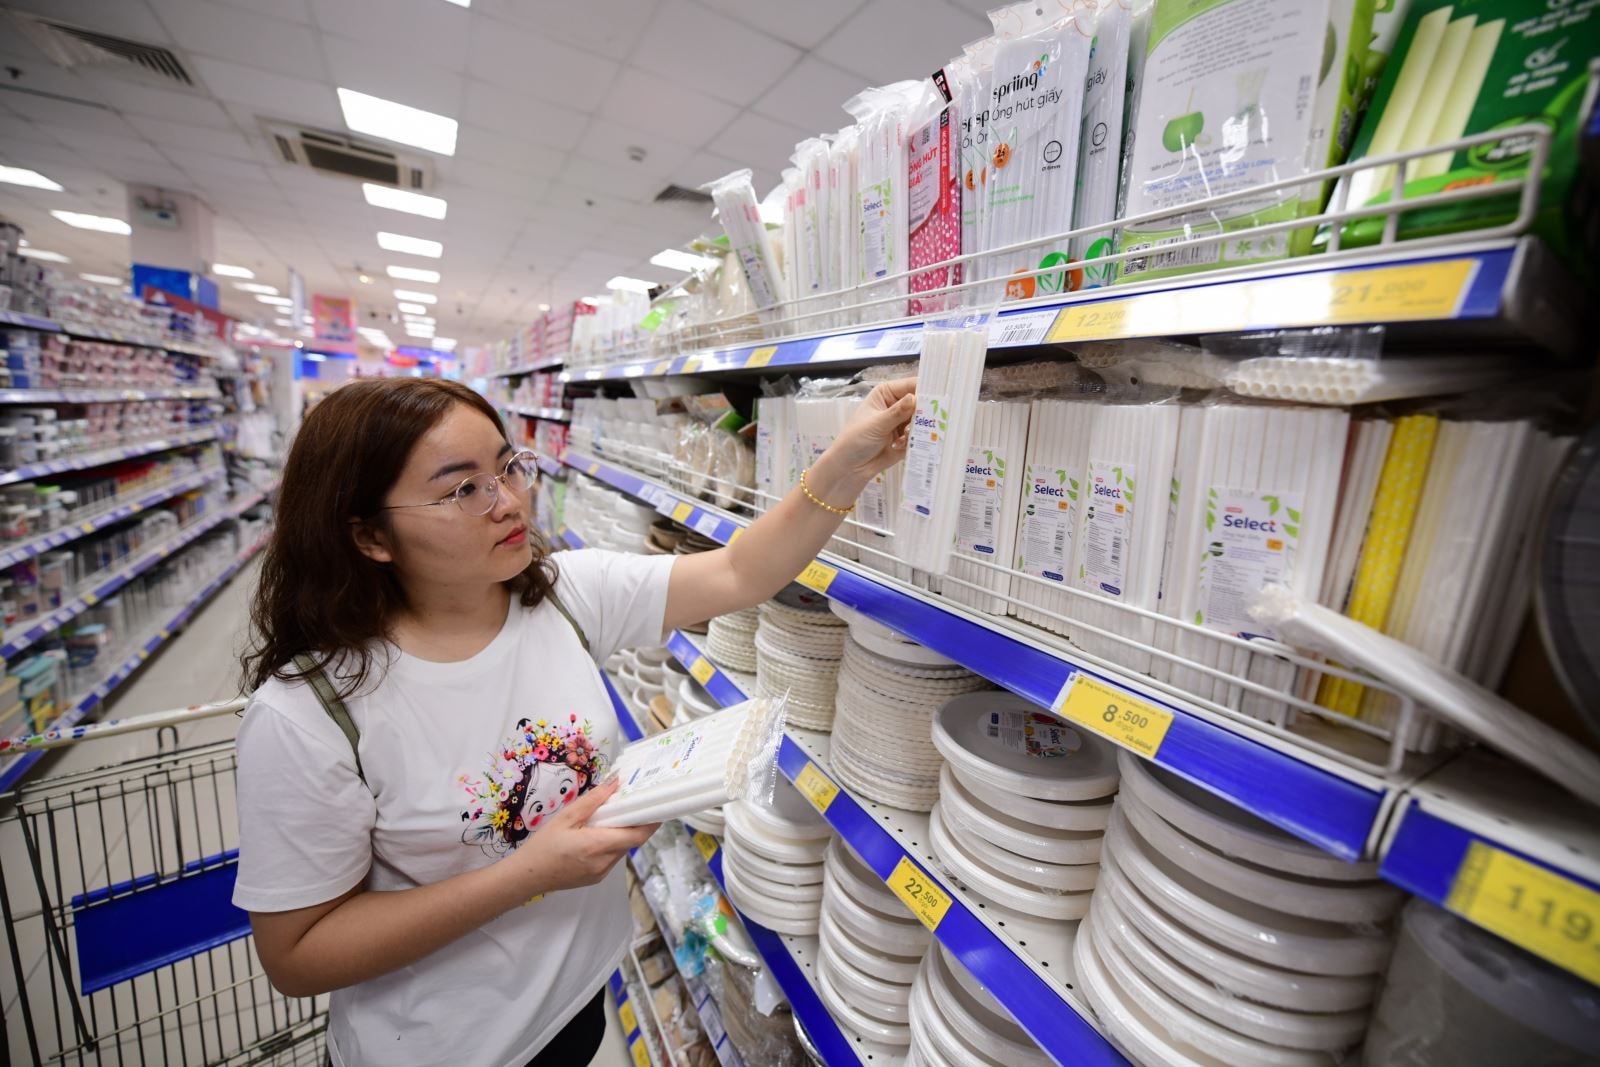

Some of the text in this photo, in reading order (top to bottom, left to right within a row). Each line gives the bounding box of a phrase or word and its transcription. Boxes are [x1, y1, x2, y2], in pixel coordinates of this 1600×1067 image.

[1015, 98, 1034, 113] hút
[1037, 86, 1063, 109] giấy
[915, 415, 936, 428] Select
[965, 464, 992, 476] Select
[1034, 484, 1064, 497] Select
[1094, 484, 1121, 499] Select
[1223, 514, 1276, 533] Select
[1102, 704, 1149, 729] 8.500
[904, 877, 938, 908] 22.500
